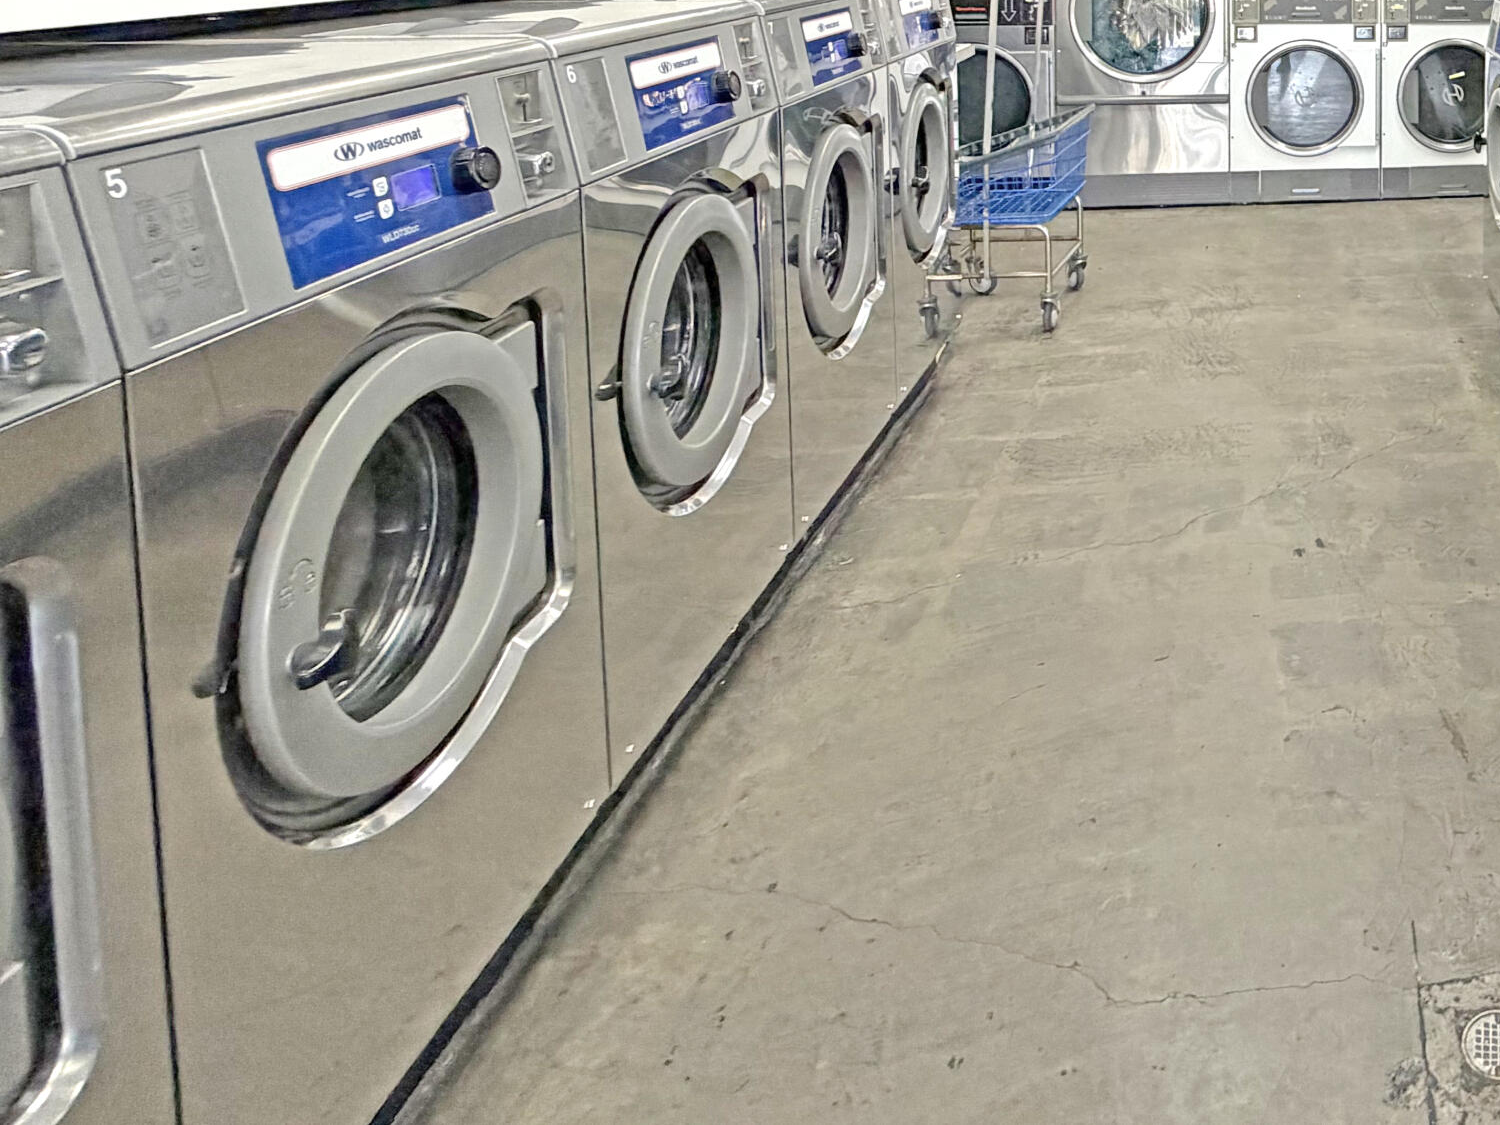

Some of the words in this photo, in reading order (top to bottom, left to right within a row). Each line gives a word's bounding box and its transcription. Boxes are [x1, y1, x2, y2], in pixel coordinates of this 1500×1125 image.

[565, 64, 577, 84] 6
[366, 127, 423, 152] wascomat
[105, 168, 128, 199] 5
